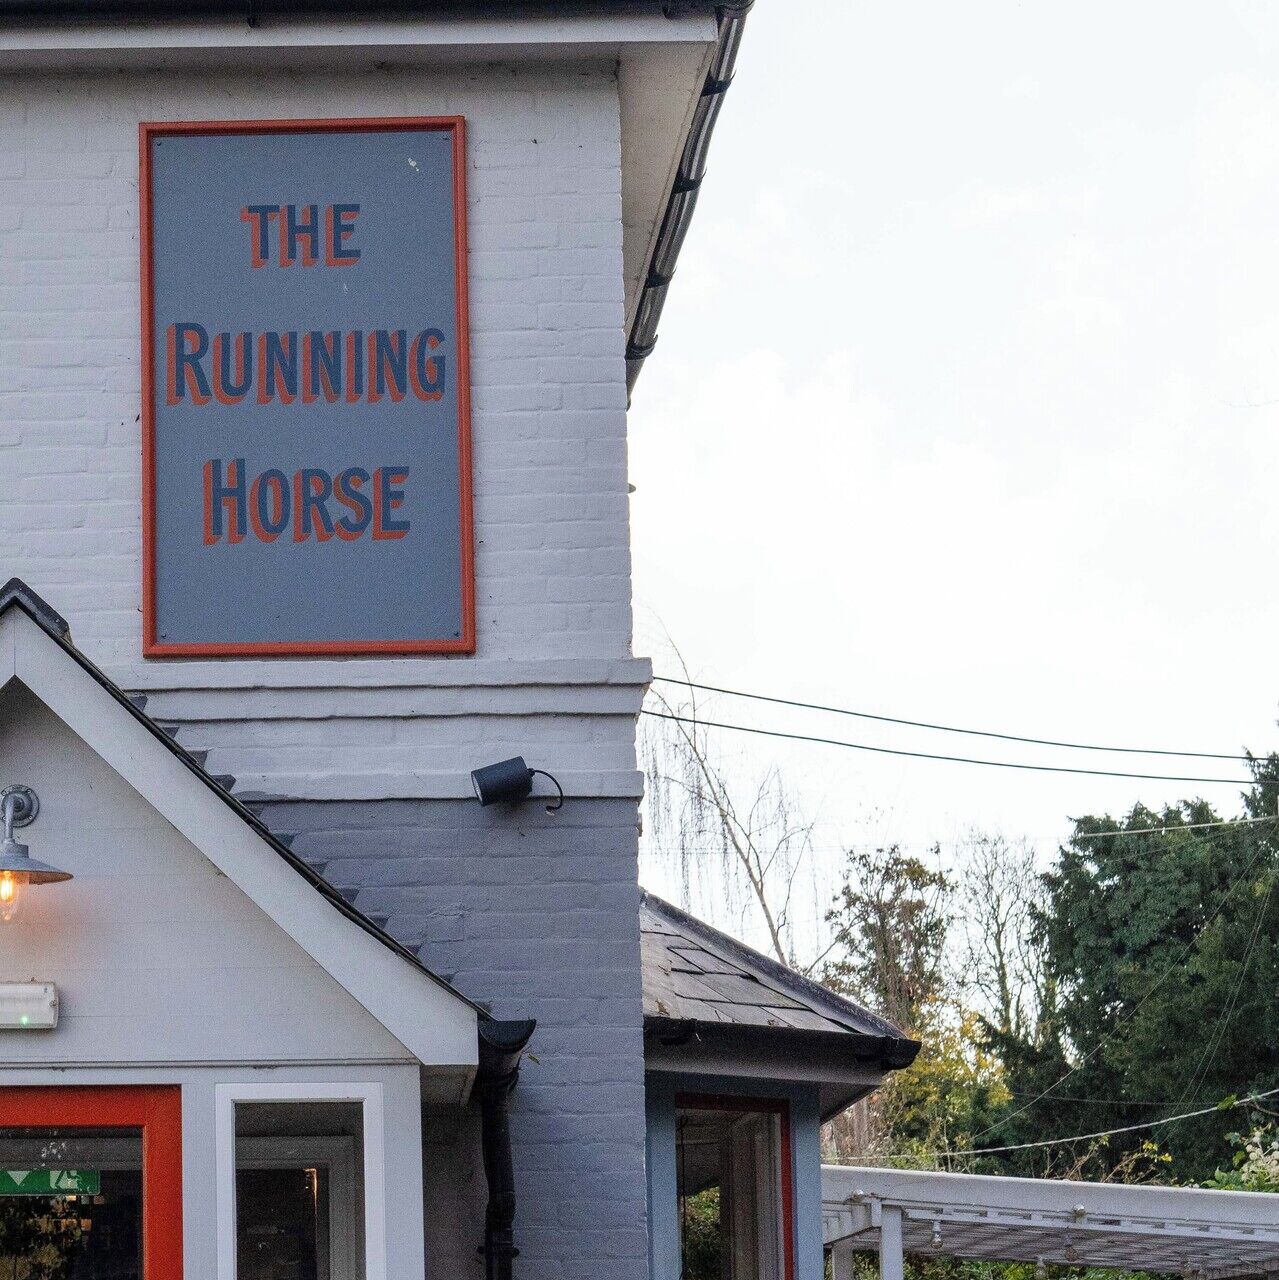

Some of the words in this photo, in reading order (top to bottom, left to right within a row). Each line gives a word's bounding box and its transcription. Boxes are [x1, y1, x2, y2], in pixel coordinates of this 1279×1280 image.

[241, 203, 362, 269] THE
[166, 322, 447, 407] RUNNING
[203, 458, 411, 546] HORSE
